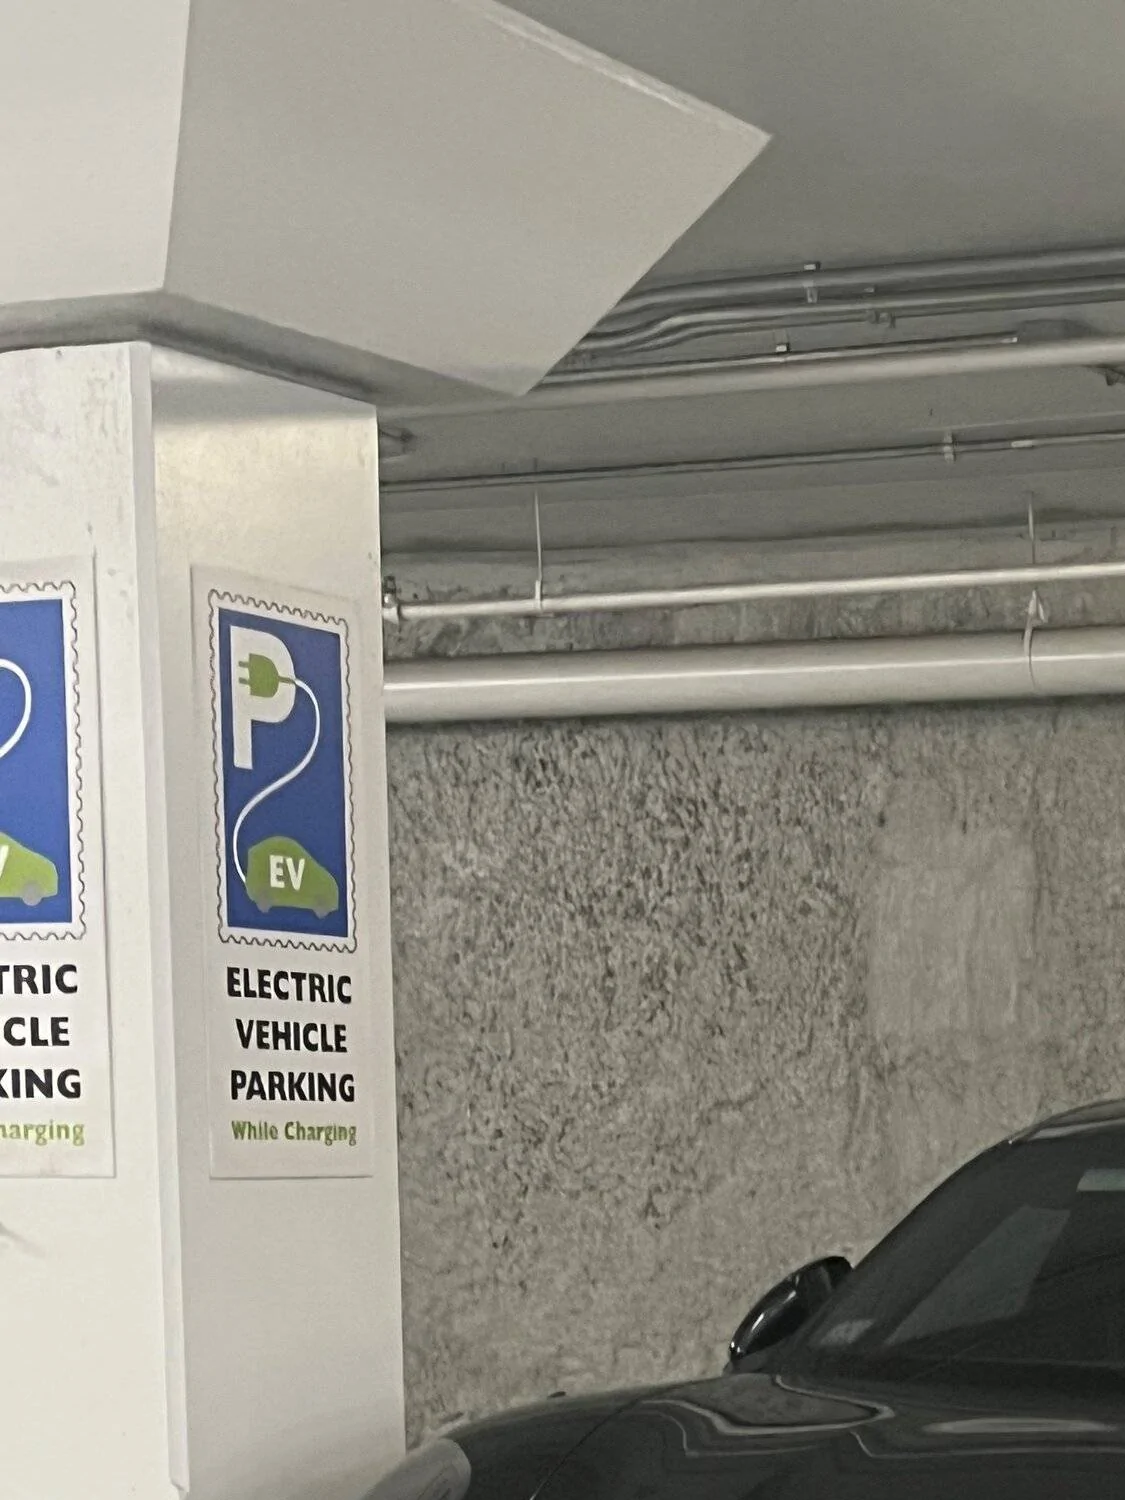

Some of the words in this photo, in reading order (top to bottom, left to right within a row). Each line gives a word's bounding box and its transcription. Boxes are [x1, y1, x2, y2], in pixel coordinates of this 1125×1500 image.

[269, 854, 306, 895] EV
[226, 966, 352, 1004] ELECTRIC
[235, 1018, 348, 1053] VEHICLE
[230, 1070, 355, 1103] PARKING
[231, 1120, 279, 1141] While
[284, 1121, 358, 1147] Charging
